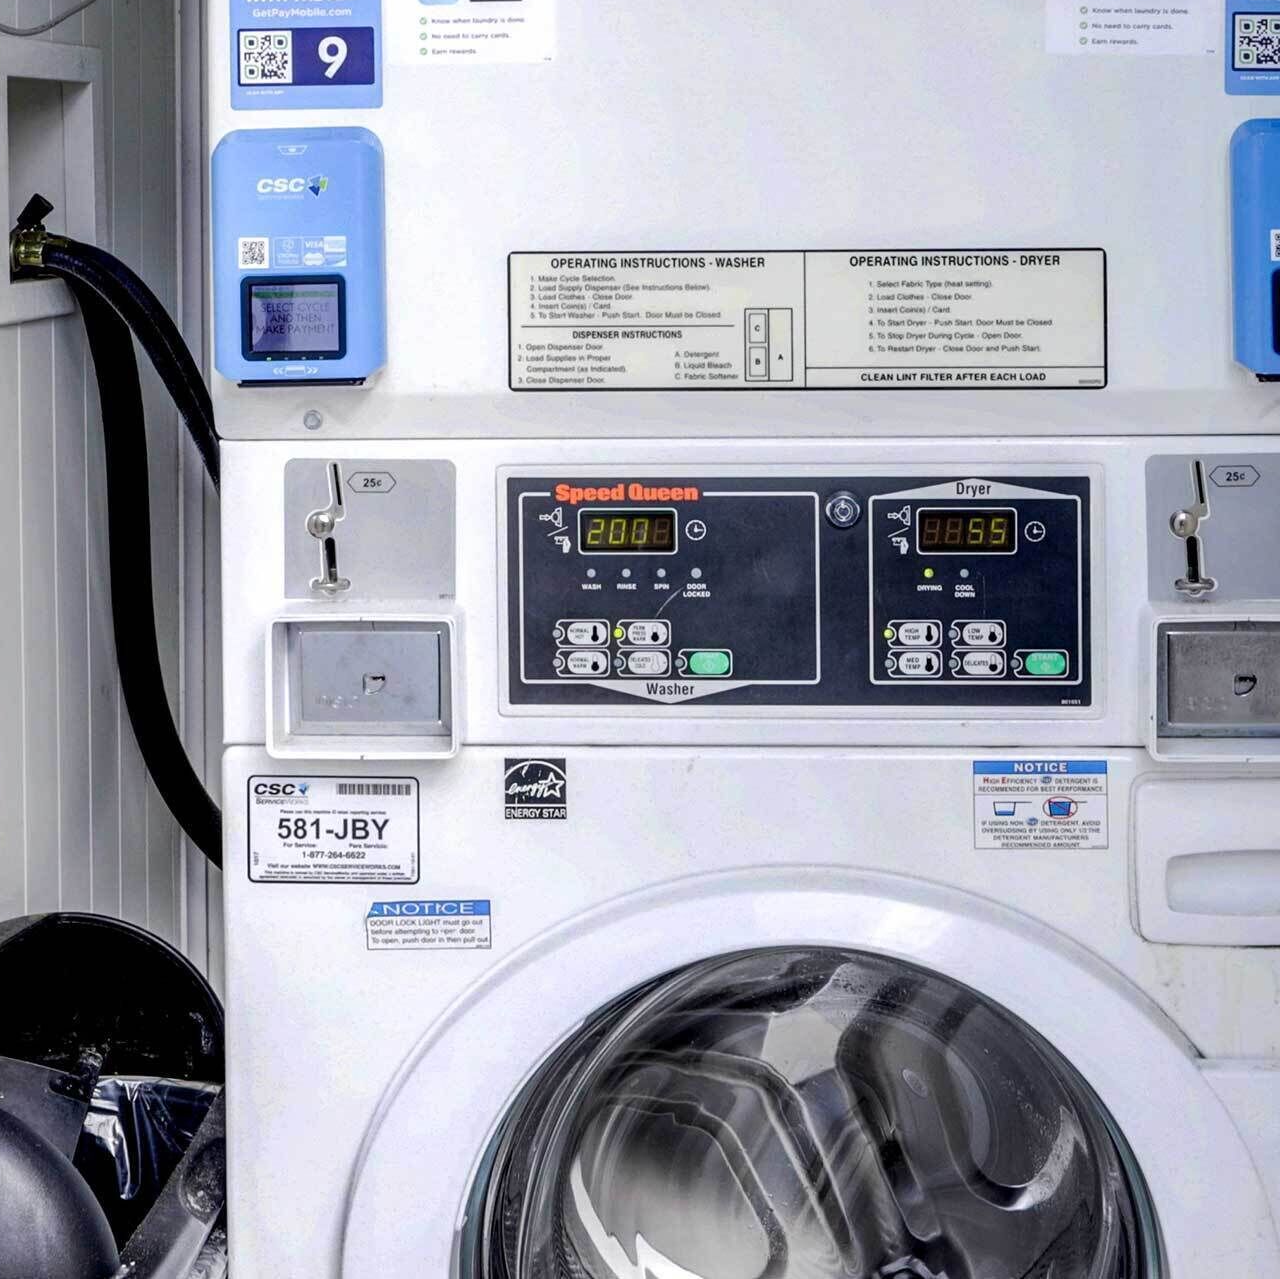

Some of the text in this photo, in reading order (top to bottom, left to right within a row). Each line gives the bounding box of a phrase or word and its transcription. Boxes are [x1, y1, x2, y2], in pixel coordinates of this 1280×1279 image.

[252, 6, 352, 19] GetPayMobile.com
[318, 36, 347, 79] 9
[257, 178, 305, 193] CSC
[551, 258, 617, 269] OPERATING
[620, 257, 706, 268] INSTRUCTIONS
[715, 257, 765, 268] WASHER
[849, 255, 918, 267] OPERATING
[921, 255, 1009, 267] INSTRUCTIONS
[1020, 255, 1060, 266] DRYER
[261, 302, 329, 314] SELECT CYCLE
[269, 312, 321, 324] AND THEN
[256, 323, 334, 335] MAKE PAYMENT
[572, 330, 682, 339] DISPENSER INSTRUCTIONS
[861, 373, 1046, 382] CLEAN LINT FILTER AFTER EACH LOAD
[555, 483, 699, 504] Speed Queen
[956, 482, 991, 498] Dryer
[969, 518, 1005, 544] 55
[646, 682, 694, 696] Washer
[1014, 762, 1067, 772] NOTICE
[254, 783, 296, 796] CSC
[505, 807, 566, 819] ENERGY STAR
[278, 818, 389, 840] 581-JBY
[302, 851, 366, 859] 1-877-264-6622
[383, 902, 474, 915] NOTICE
